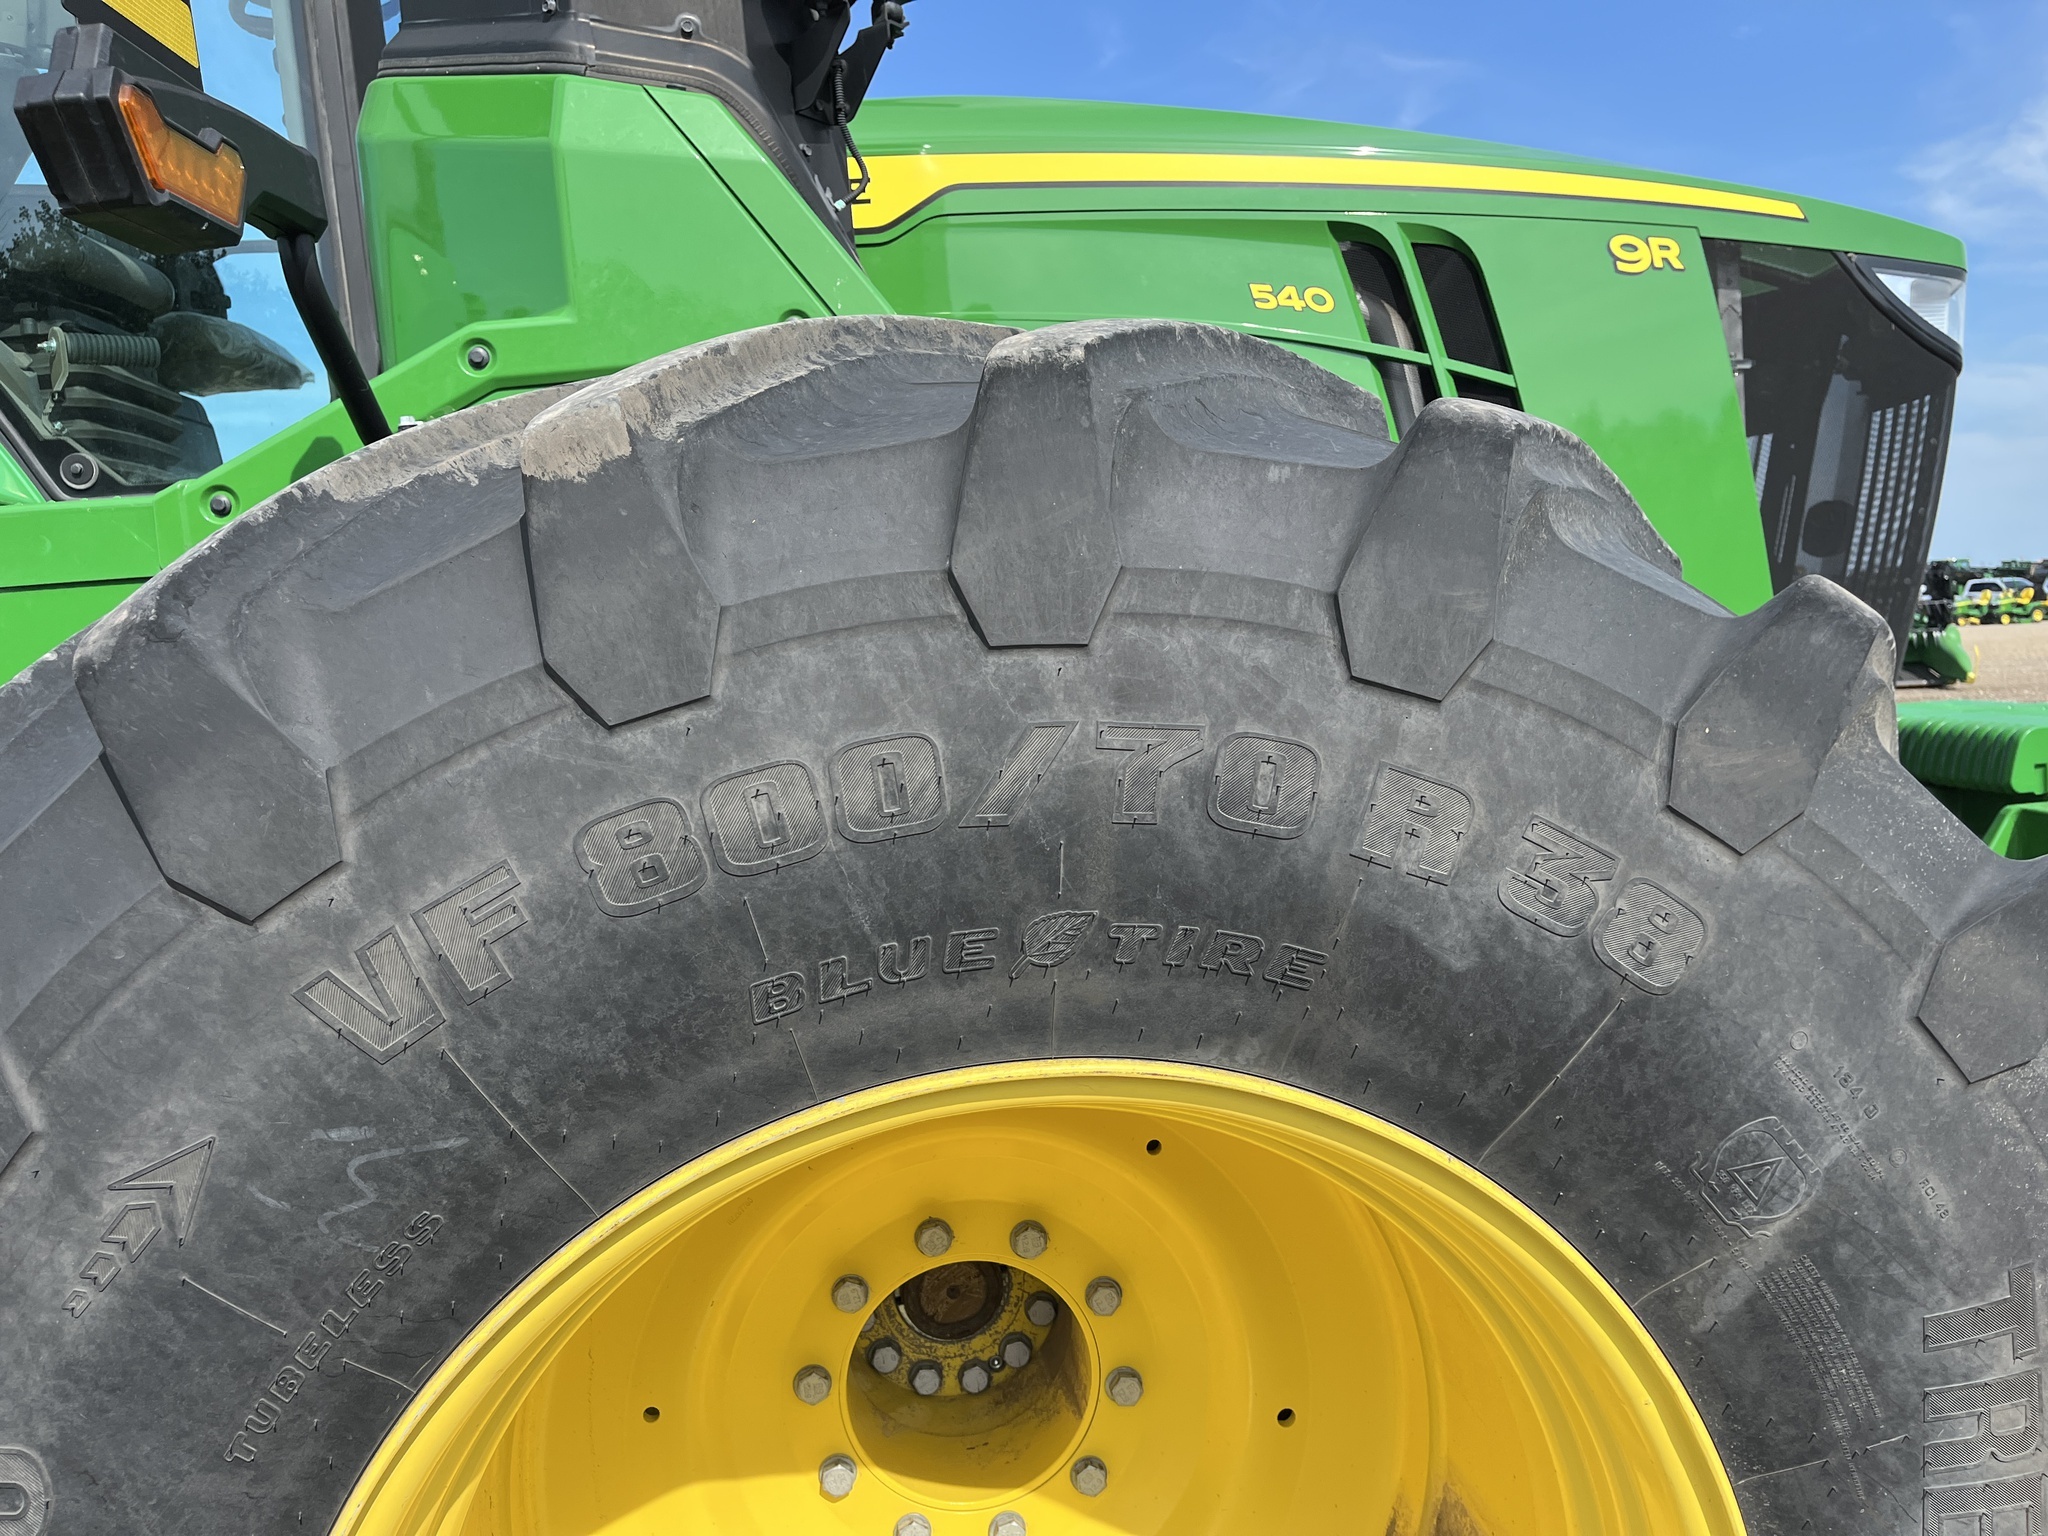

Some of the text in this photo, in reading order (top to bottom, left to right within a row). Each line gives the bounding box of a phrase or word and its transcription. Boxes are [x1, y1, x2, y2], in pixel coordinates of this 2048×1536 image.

[1248, 282, 1335, 314] 540
[1607, 233, 1686, 275] 9R
[290, 858, 529, 1064] VF
[572, 721, 1322, 918] 800/70
[750, 922, 1330, 1026] BLUE TIRE
[223, 1210, 444, 1463] TUBELESS
